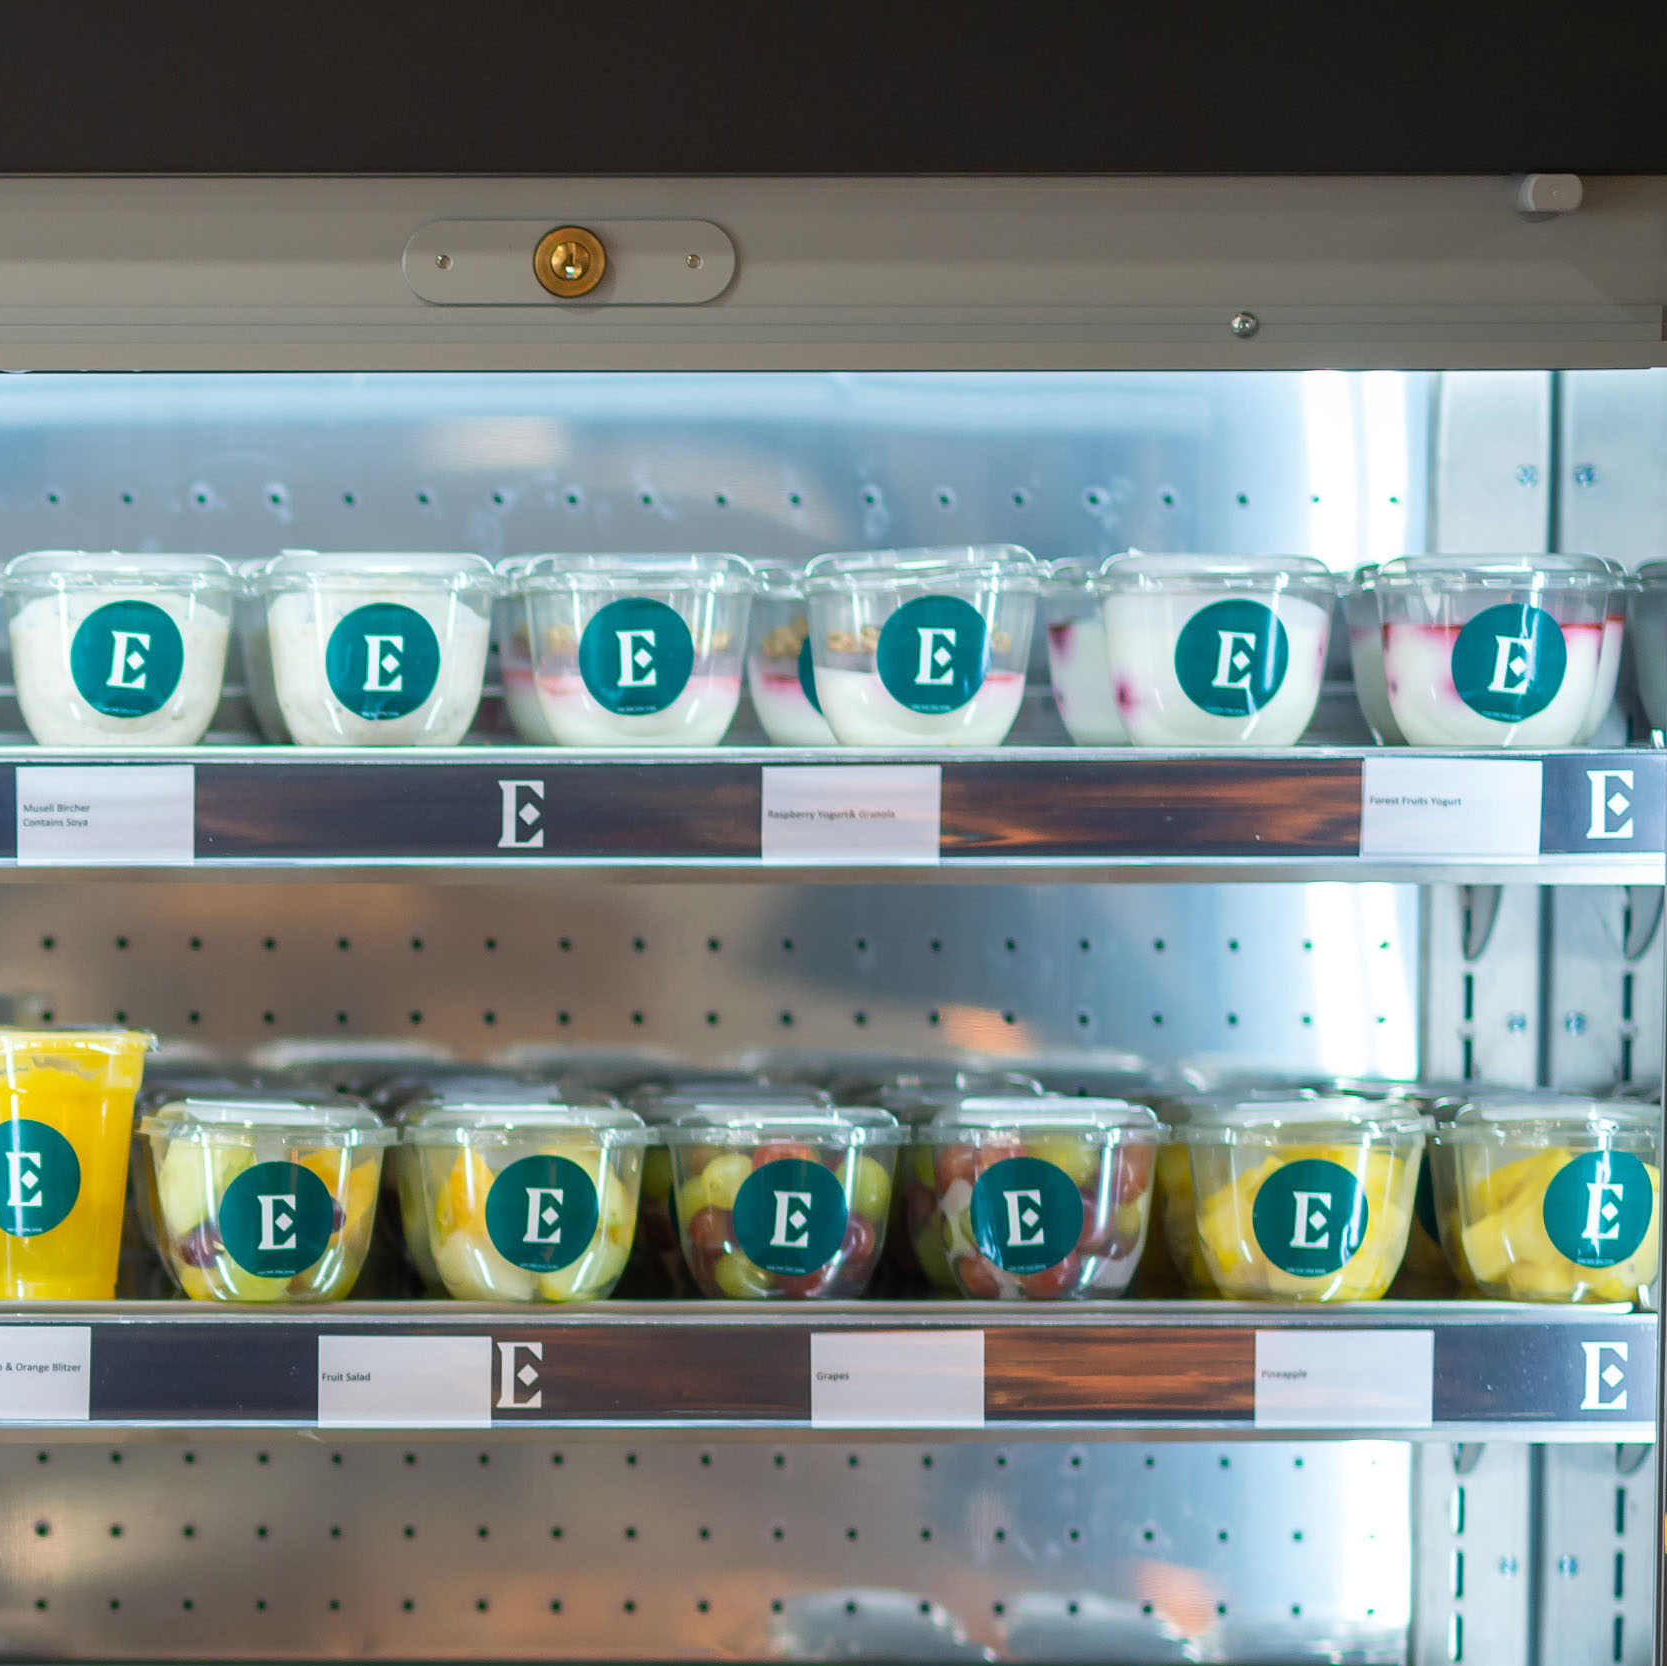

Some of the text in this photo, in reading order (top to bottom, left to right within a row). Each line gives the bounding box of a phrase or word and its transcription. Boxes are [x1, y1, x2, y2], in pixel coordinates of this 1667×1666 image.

[56, 803, 91, 813] Bircher
[1369, 795, 1462, 809] Forest Fruits Yogurt
[1586, 770, 1633, 839] E
[498, 780, 544, 847] E
[22, 817, 89, 828] Contains Soya
[6, 1151, 43, 1206] E
[4, 1361, 14, 1372] &
[15, 1362, 51, 1374] Orange
[52, 1362, 82, 1372] Blitzer
[321, 1371, 372, 1382] Fruit Salad
[496, 1342, 542, 1408] E
[816, 1371, 850, 1383] Grapes
[1581, 1342, 1628, 1410] E
